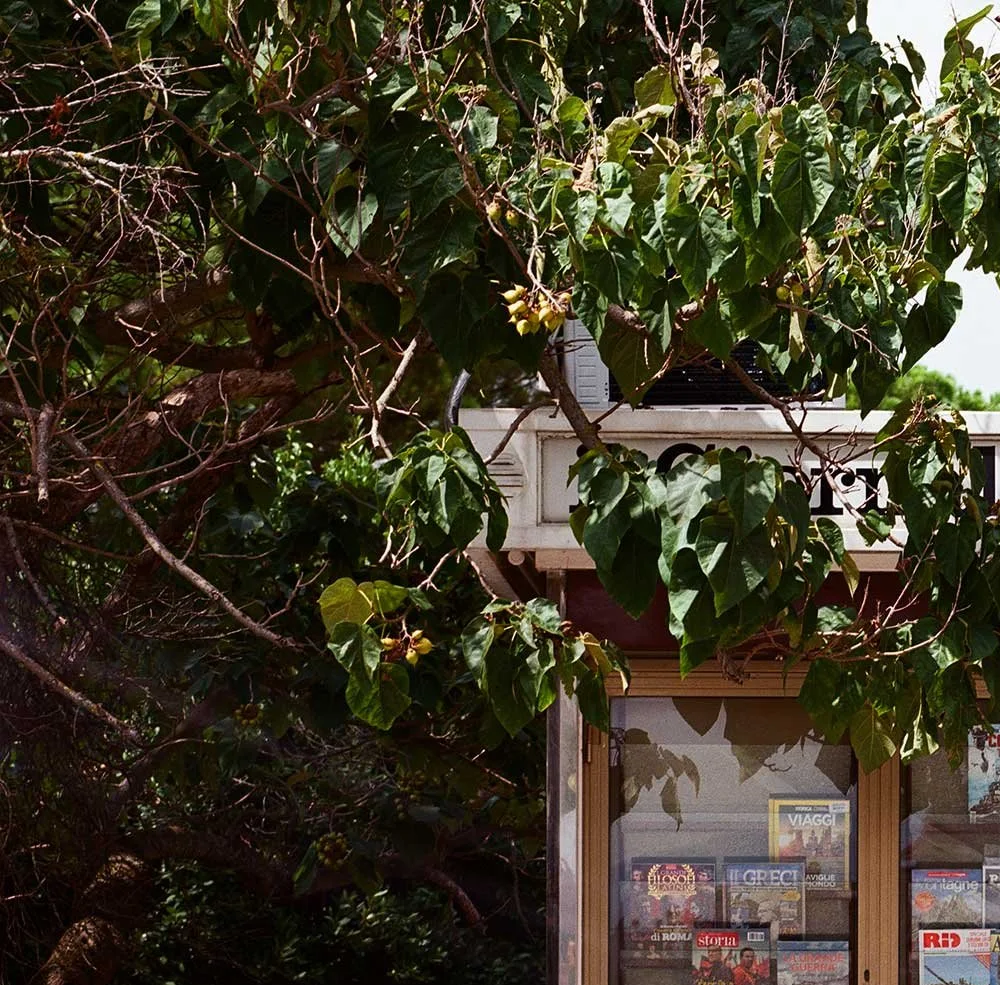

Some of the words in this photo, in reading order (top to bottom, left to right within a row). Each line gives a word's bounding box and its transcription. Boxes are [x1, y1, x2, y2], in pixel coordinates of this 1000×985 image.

[788, 813, 836, 826] VIAGGI
[648, 875, 696, 886] FILOSOFI
[744, 869, 799, 886] GRECI
[698, 934, 737, 947] storia
[923, 932, 961, 949] RID
